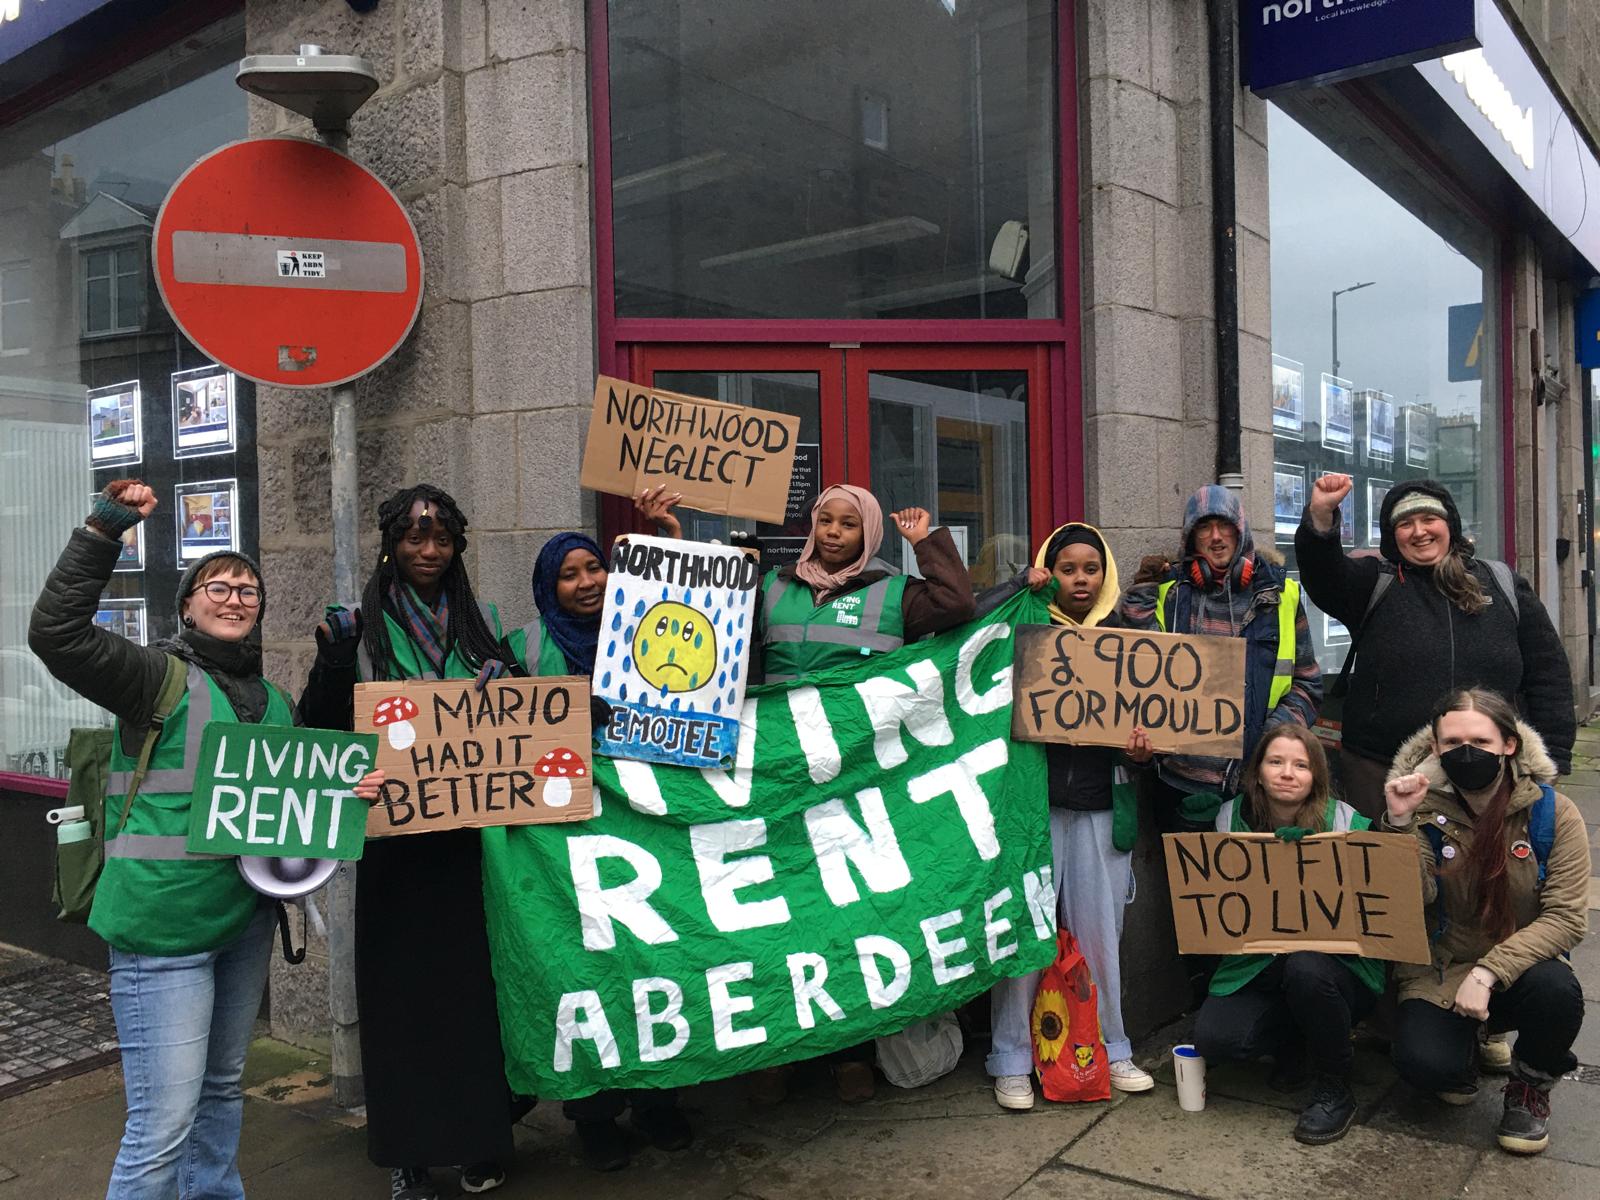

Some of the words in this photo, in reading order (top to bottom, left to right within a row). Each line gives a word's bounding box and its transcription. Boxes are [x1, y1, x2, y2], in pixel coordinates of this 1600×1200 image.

[1315, 11, 1339, 22] Local
[606, 386, 789, 453] NORTHWOOD
[619, 433, 766, 488] NEGLECT
[610, 542, 758, 591] NORTHWOOD
[832, 602, 855, 610] RENT
[433, 686, 570, 736] MARIO
[607, 706, 723, 758] EMOJEE
[1029, 689, 1105, 732] FOR
[1114, 691, 1242, 735] MOULD
[213, 735, 370, 783] LIVING
[411, 740, 484, 776] HAD
[496, 735, 533, 766] IT
[206, 785, 361, 849] RENT
[381, 771, 535, 826] BETTER
[566, 738, 1009, 951] RENT
[1174, 834, 1280, 886] NOT
[1297, 840, 1381, 887] FIT
[1179, 891, 1251, 938] TO
[1272, 889, 1394, 938] LIVE
[554, 865, 1057, 1072] ABERDEEN
